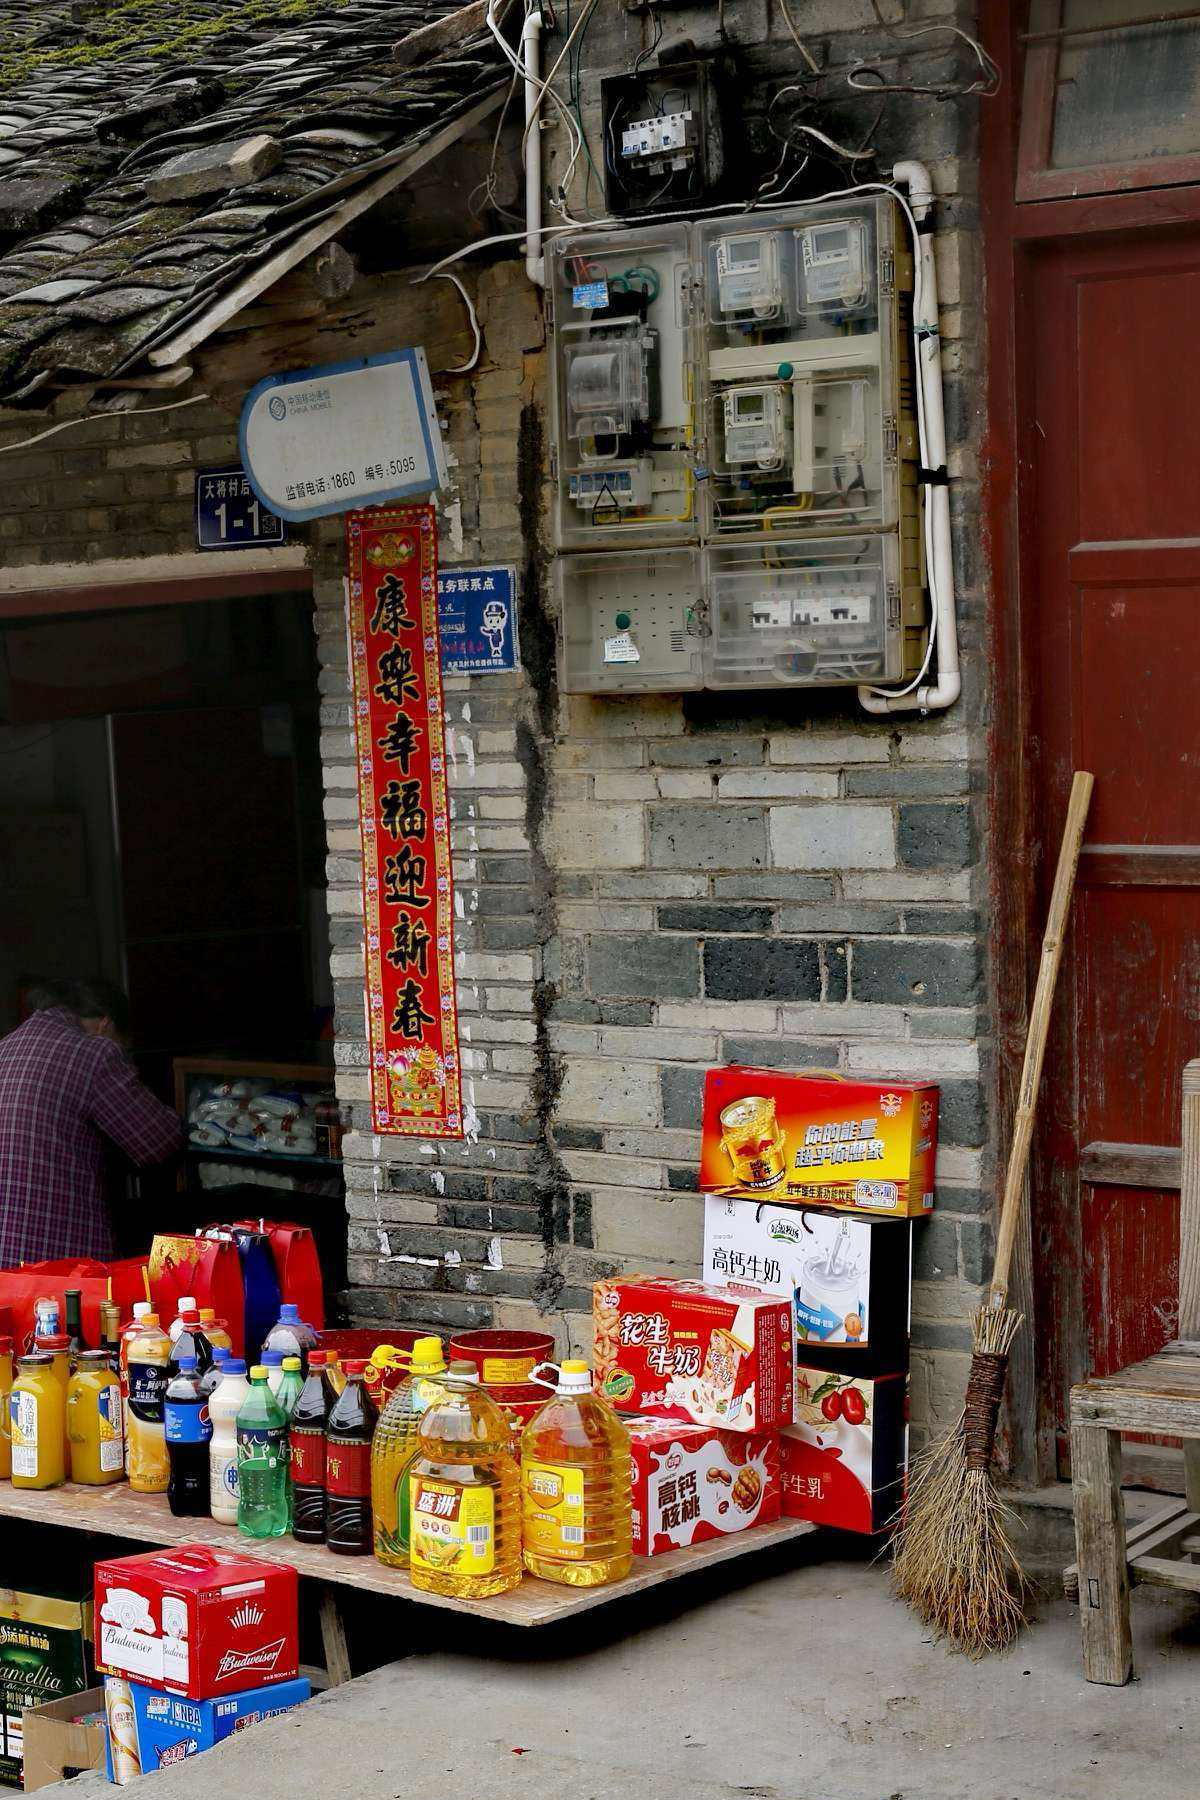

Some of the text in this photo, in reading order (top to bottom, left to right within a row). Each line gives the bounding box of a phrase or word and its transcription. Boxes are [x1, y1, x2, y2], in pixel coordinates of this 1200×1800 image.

[285, 456, 416, 500] 监督电话:1860 编号:5095
[214, 501, 259, 538] 1-1
[369, 575, 434, 1042] 康樂幸福迎新春
[804, 1119, 878, 1147] 你的能量
[860, 1183, 894, 1200] 净含量
[712, 1247, 781, 1283] 高钙牛奶
[620, 1312, 670, 1347] 花生
[648, 1345, 700, 1377] 牛奶
[416, 1491, 456, 1517] 盛洲
[657, 1470, 697, 1509] 高钙
[661, 1496, 701, 1532] 核桃
[105, 1627, 153, 1654] Budweiser
[220, 1651, 279, 1672] Budweiser
[181, 1705, 202, 1726] NBA
